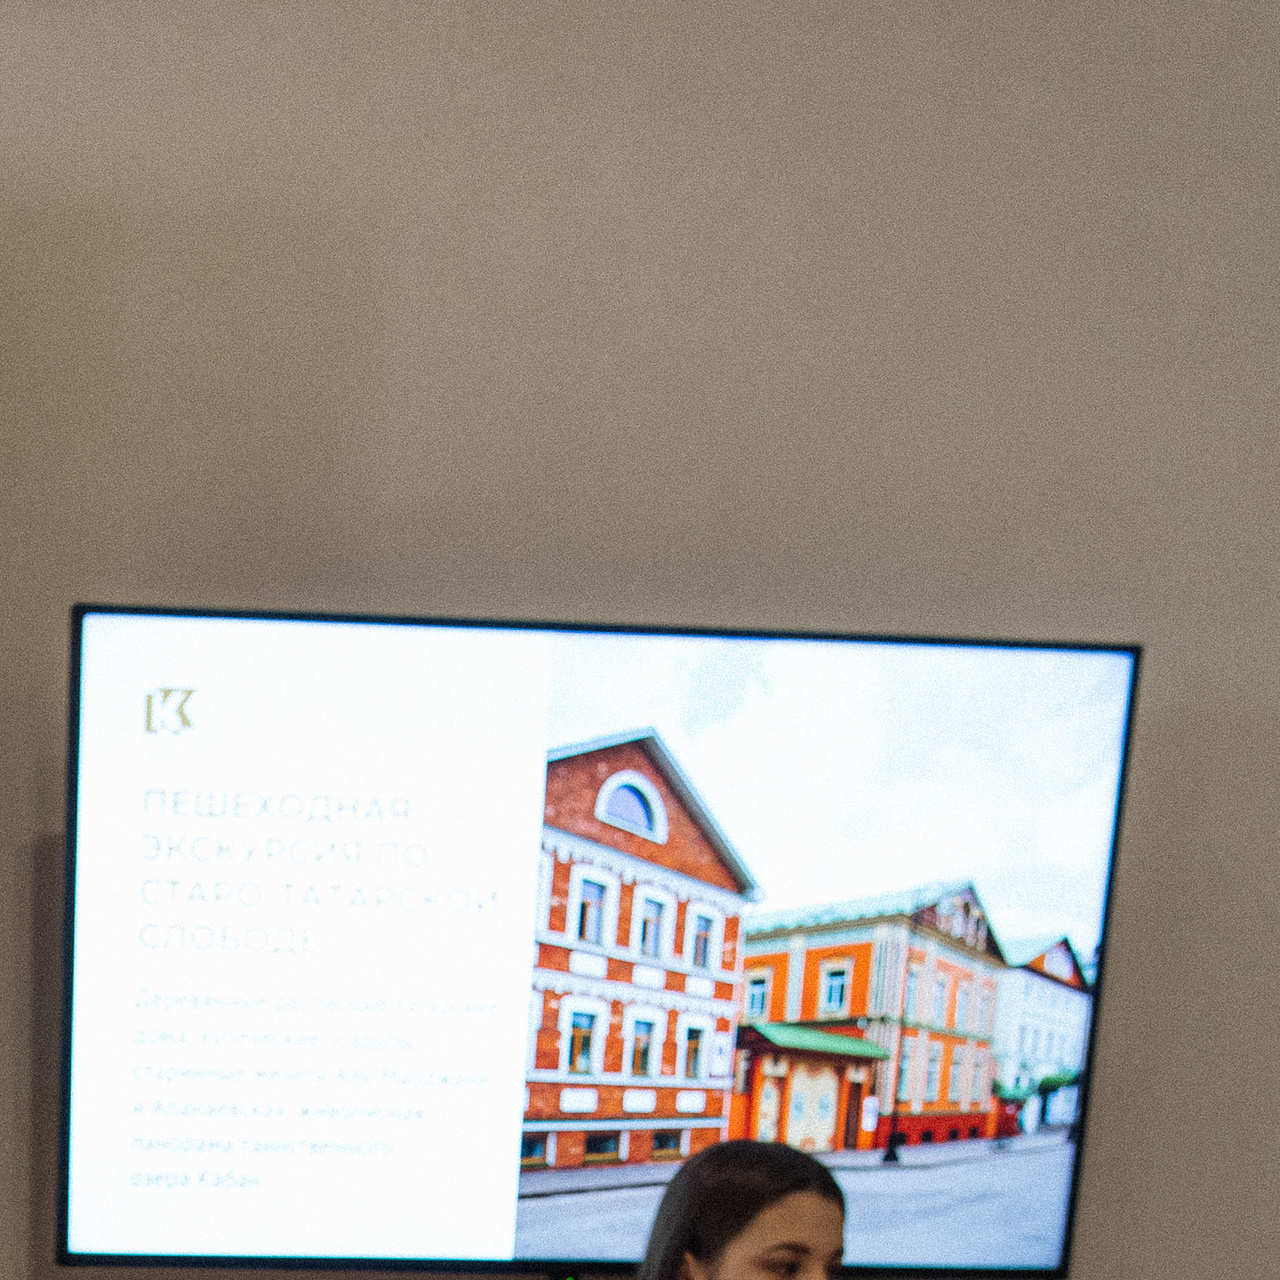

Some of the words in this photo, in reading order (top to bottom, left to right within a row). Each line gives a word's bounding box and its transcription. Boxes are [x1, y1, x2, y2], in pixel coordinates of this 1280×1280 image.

[142, 786, 412, 824] ПЕШЕХОДНАЯ
[141, 832, 363, 865] ЭКСКУРСИЯ
[376, 840, 429, 869] ПО
[137, 922, 318, 956] СЛОБОДЕ
